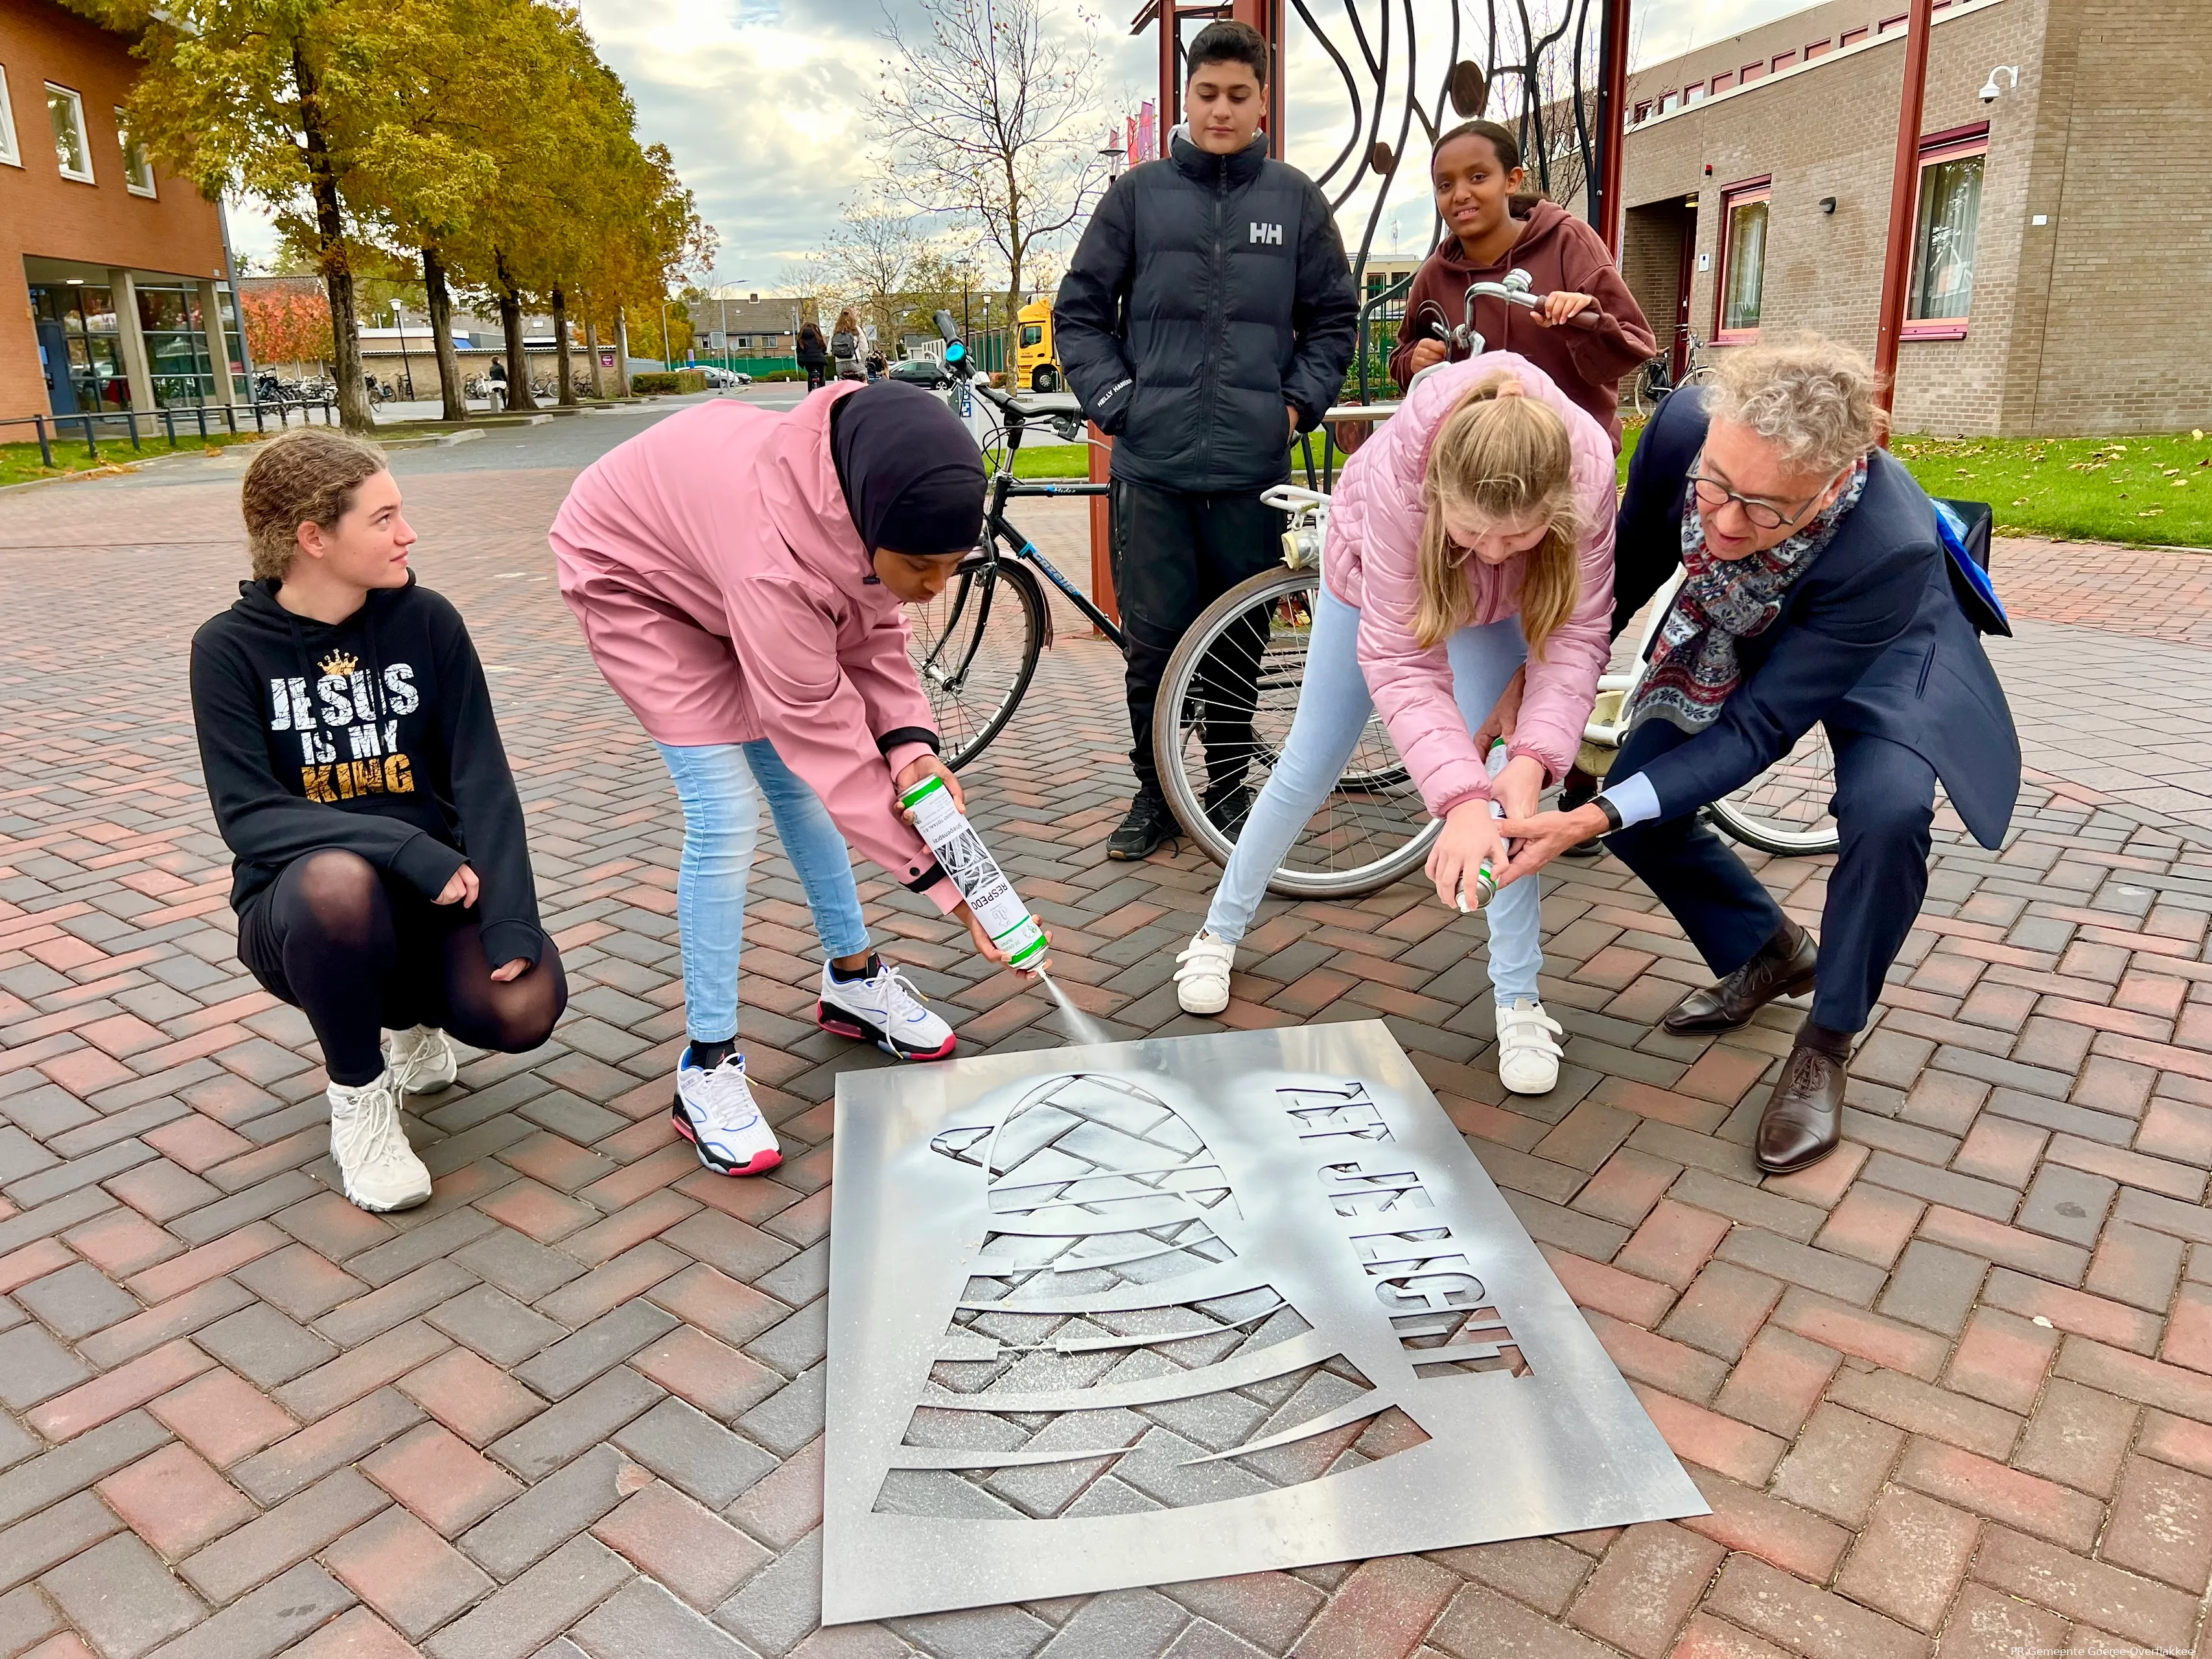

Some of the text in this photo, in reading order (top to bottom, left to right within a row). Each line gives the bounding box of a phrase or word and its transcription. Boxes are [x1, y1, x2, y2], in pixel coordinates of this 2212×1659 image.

[1250, 222, 1283, 245] HH
[1097, 389, 1113, 408] HELLY
[1032, 551, 1077, 594] Gazelle
[270, 662, 420, 730] JESUS
[301, 719, 398, 765] IS MY
[301, 753, 415, 804] KING
[933, 823, 963, 844] Strepenspray
[971, 882, 1008, 910] RESPEDO
[1275, 1082, 1535, 1379] ZET JE LICHT
